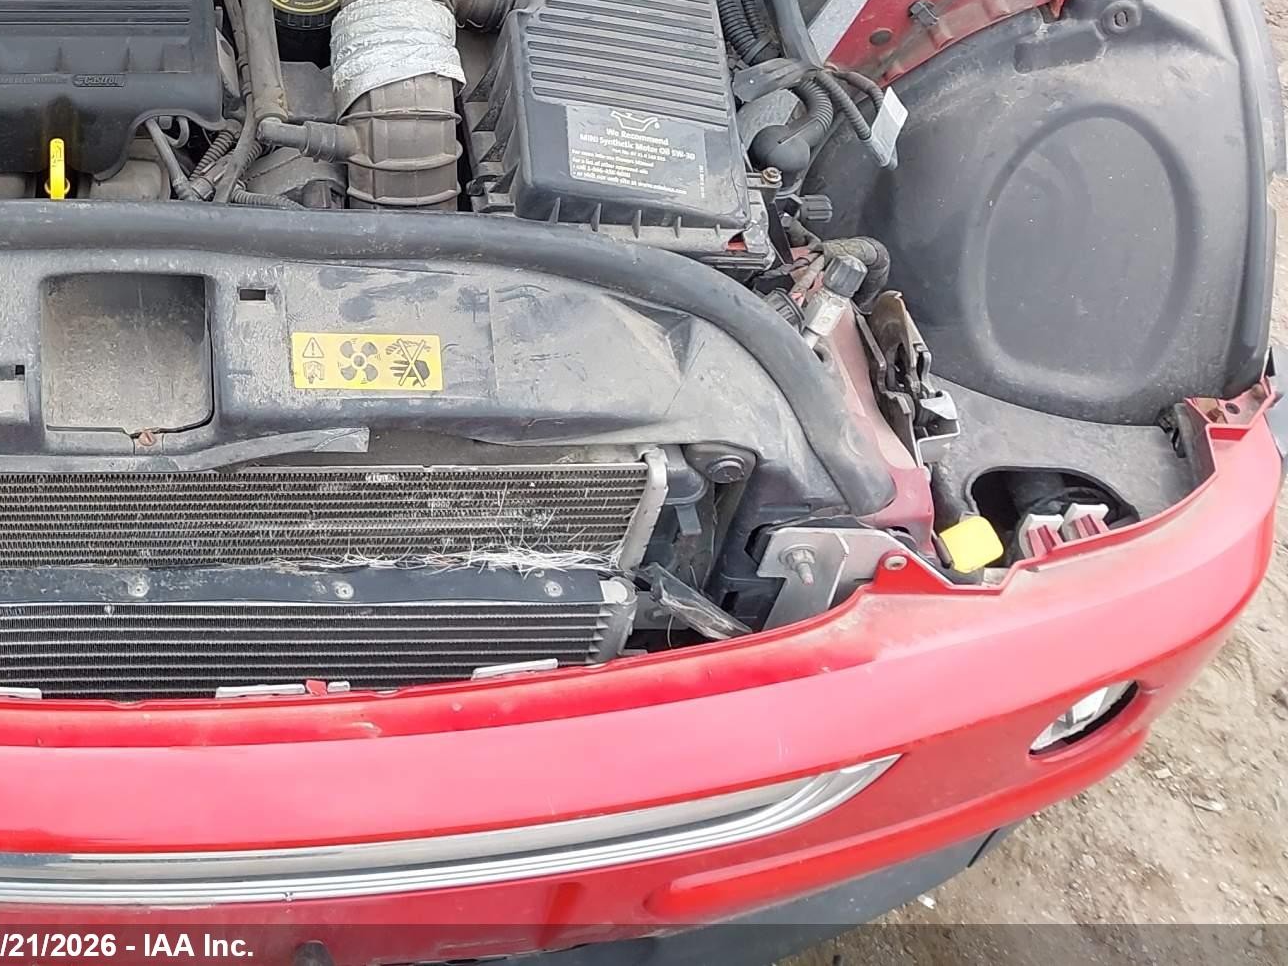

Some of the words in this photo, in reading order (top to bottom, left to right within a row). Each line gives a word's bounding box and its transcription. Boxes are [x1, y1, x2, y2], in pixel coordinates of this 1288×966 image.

[599, 136, 634, 149] Synthetic
[634, 143, 658, 153] Motor
[658, 146, 670, 155] Oil
[606, 127, 620, 137] We
[621, 130, 669, 146] Recommend
